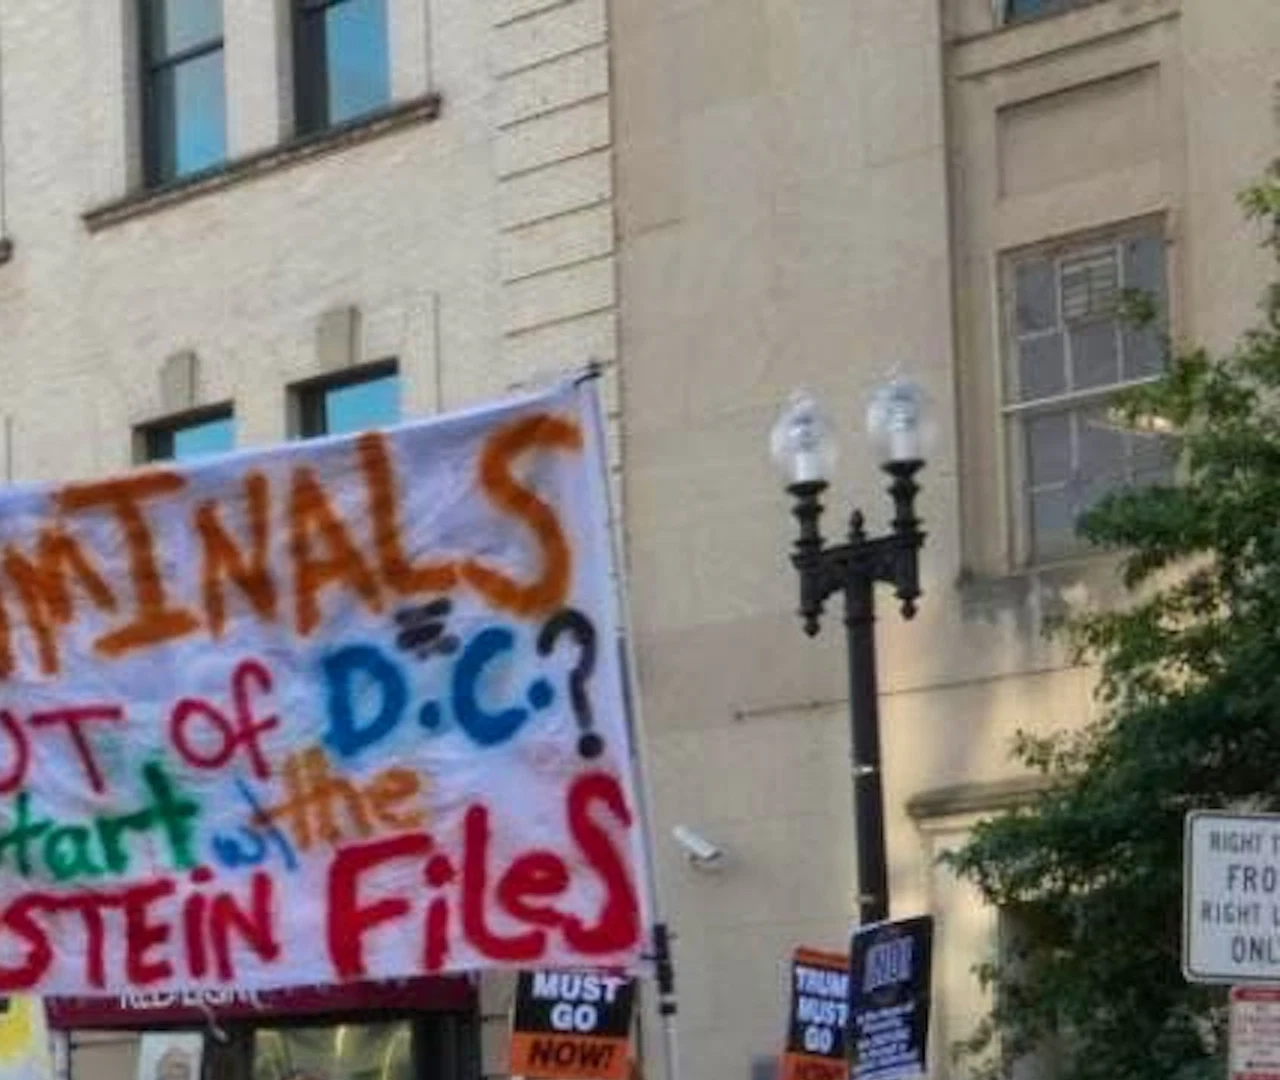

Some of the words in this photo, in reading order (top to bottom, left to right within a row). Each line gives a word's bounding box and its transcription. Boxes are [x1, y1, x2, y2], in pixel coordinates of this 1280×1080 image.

[260, 747, 428, 848] the
[1209, 830, 1262, 854] RIGHT
[1226, 864, 1277, 893] FRO
[1200, 902, 1261, 926] RIGHT
[1230, 935, 1280, 965] ONL
[531, 971, 629, 1004] MUST
[795, 965, 850, 999] TRUM
[550, 1002, 598, 1032] GO
[797, 996, 849, 1029] MUST
[526, 1038, 617, 1071] NOW!
[803, 1026, 833, 1053] GO
